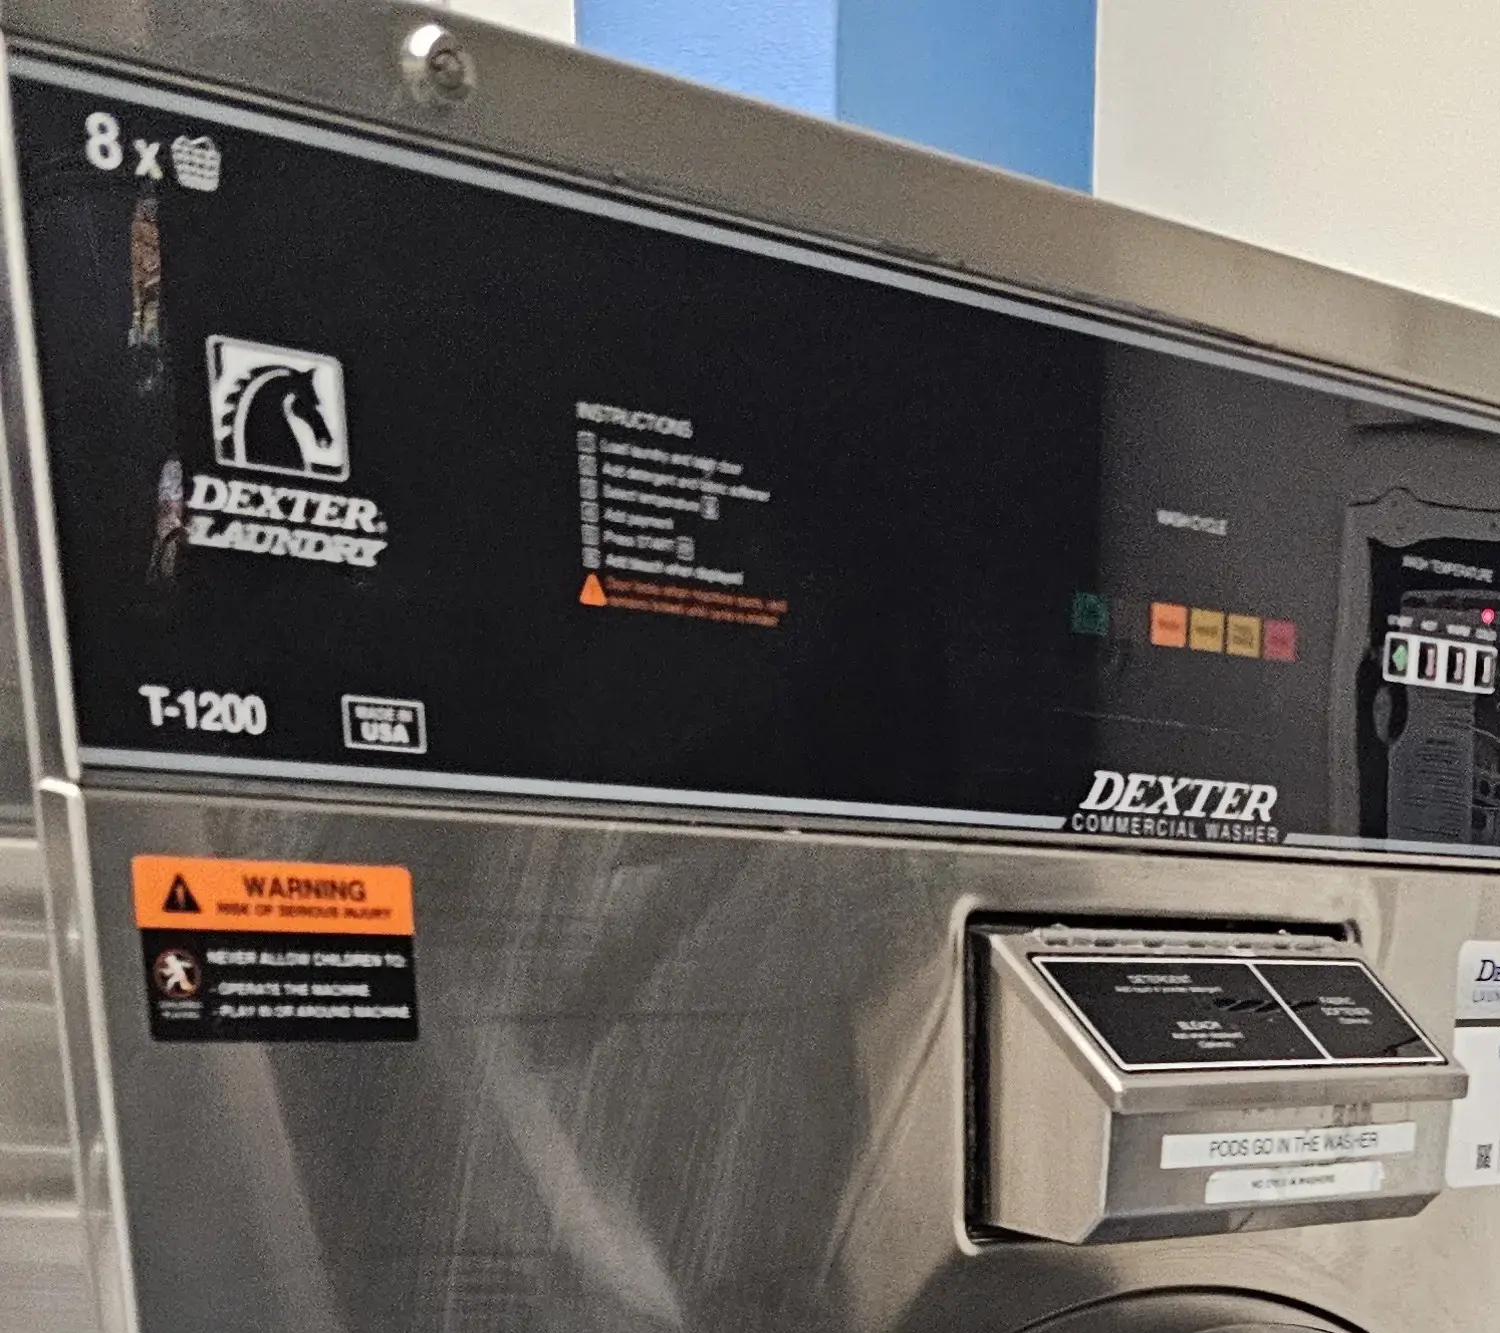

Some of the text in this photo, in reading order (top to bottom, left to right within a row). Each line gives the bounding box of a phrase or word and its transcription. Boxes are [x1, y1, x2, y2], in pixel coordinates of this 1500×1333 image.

[85, 112, 163, 180] 8 x
[187, 474, 378, 533] DEXTER
[187, 516, 388, 567] LAUNDRY
[139, 686, 267, 736] T-1200
[360, 721, 410, 743] USA
[1079, 770, 1278, 822] DEXTER
[1071, 812, 1280, 844] COMMERCIAL WASHER
[243, 874, 367, 901] WARNING
[1209, 1131, 1379, 1158] PODS GO IN THE WASHER
